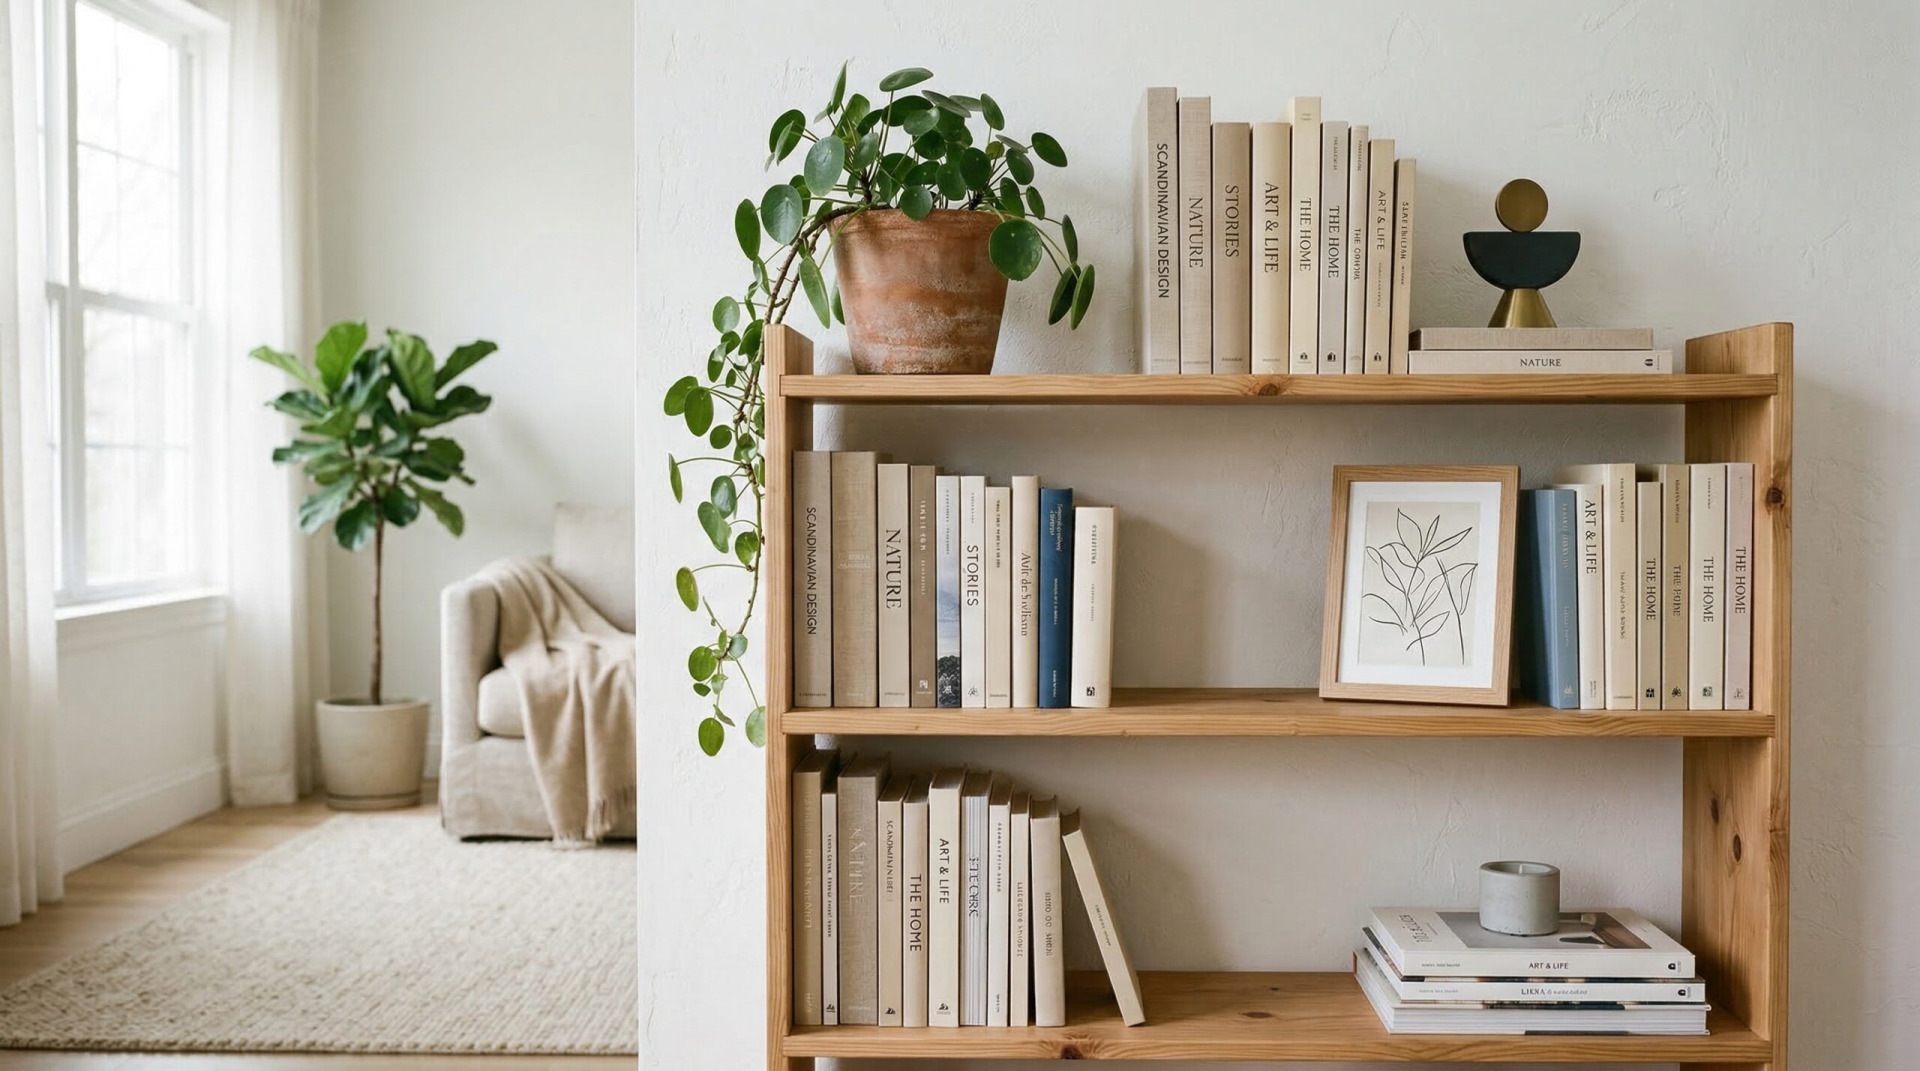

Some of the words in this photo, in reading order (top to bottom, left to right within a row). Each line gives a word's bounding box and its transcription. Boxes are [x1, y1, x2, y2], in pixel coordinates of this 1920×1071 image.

[1157, 143, 1169, 245] SCANDINAVIAN
[1265, 183, 1278, 216] ART
[1377, 190, 1386, 213] ART
[1225, 185, 1239, 257] STORIES
[1265, 220, 1278, 231] &
[1300, 198, 1312, 225] THE
[1328, 206, 1340, 233] THE
[1377, 216, 1385, 224] &
[1189, 197, 1203, 268] NATURE
[1376, 228, 1385, 250] LIFE
[1264, 238, 1279, 273] LIFE
[1300, 230, 1311, 271] HOME
[1328, 237, 1339, 278] HOME
[1158, 250, 1169, 298] DESIGN
[1520, 358, 1561, 367] NATURE
[1585, 500, 1596, 526] ART
[807, 507, 816, 590] SCANDINAVIAN
[1586, 531, 1595, 540] &
[886, 529, 901, 609] NATURE
[1586, 545, 1596, 574] LIFE
[1646, 558, 1656, 582] THE
[1703, 557, 1714, 581] THE
[1736, 547, 1746, 572] THE
[967, 545, 978, 606] STORIES
[1646, 587, 1656, 620] HOME
[1703, 586, 1713, 622] HOME
[1735, 576, 1746, 613] HOME
[807, 594, 817, 634] DESIGN
[939, 839, 949, 864] ART
[939, 867, 949, 875] &
[910, 874, 921, 902] THE
[939, 879, 949, 903] LIFE
[910, 909, 921, 951] HOME
